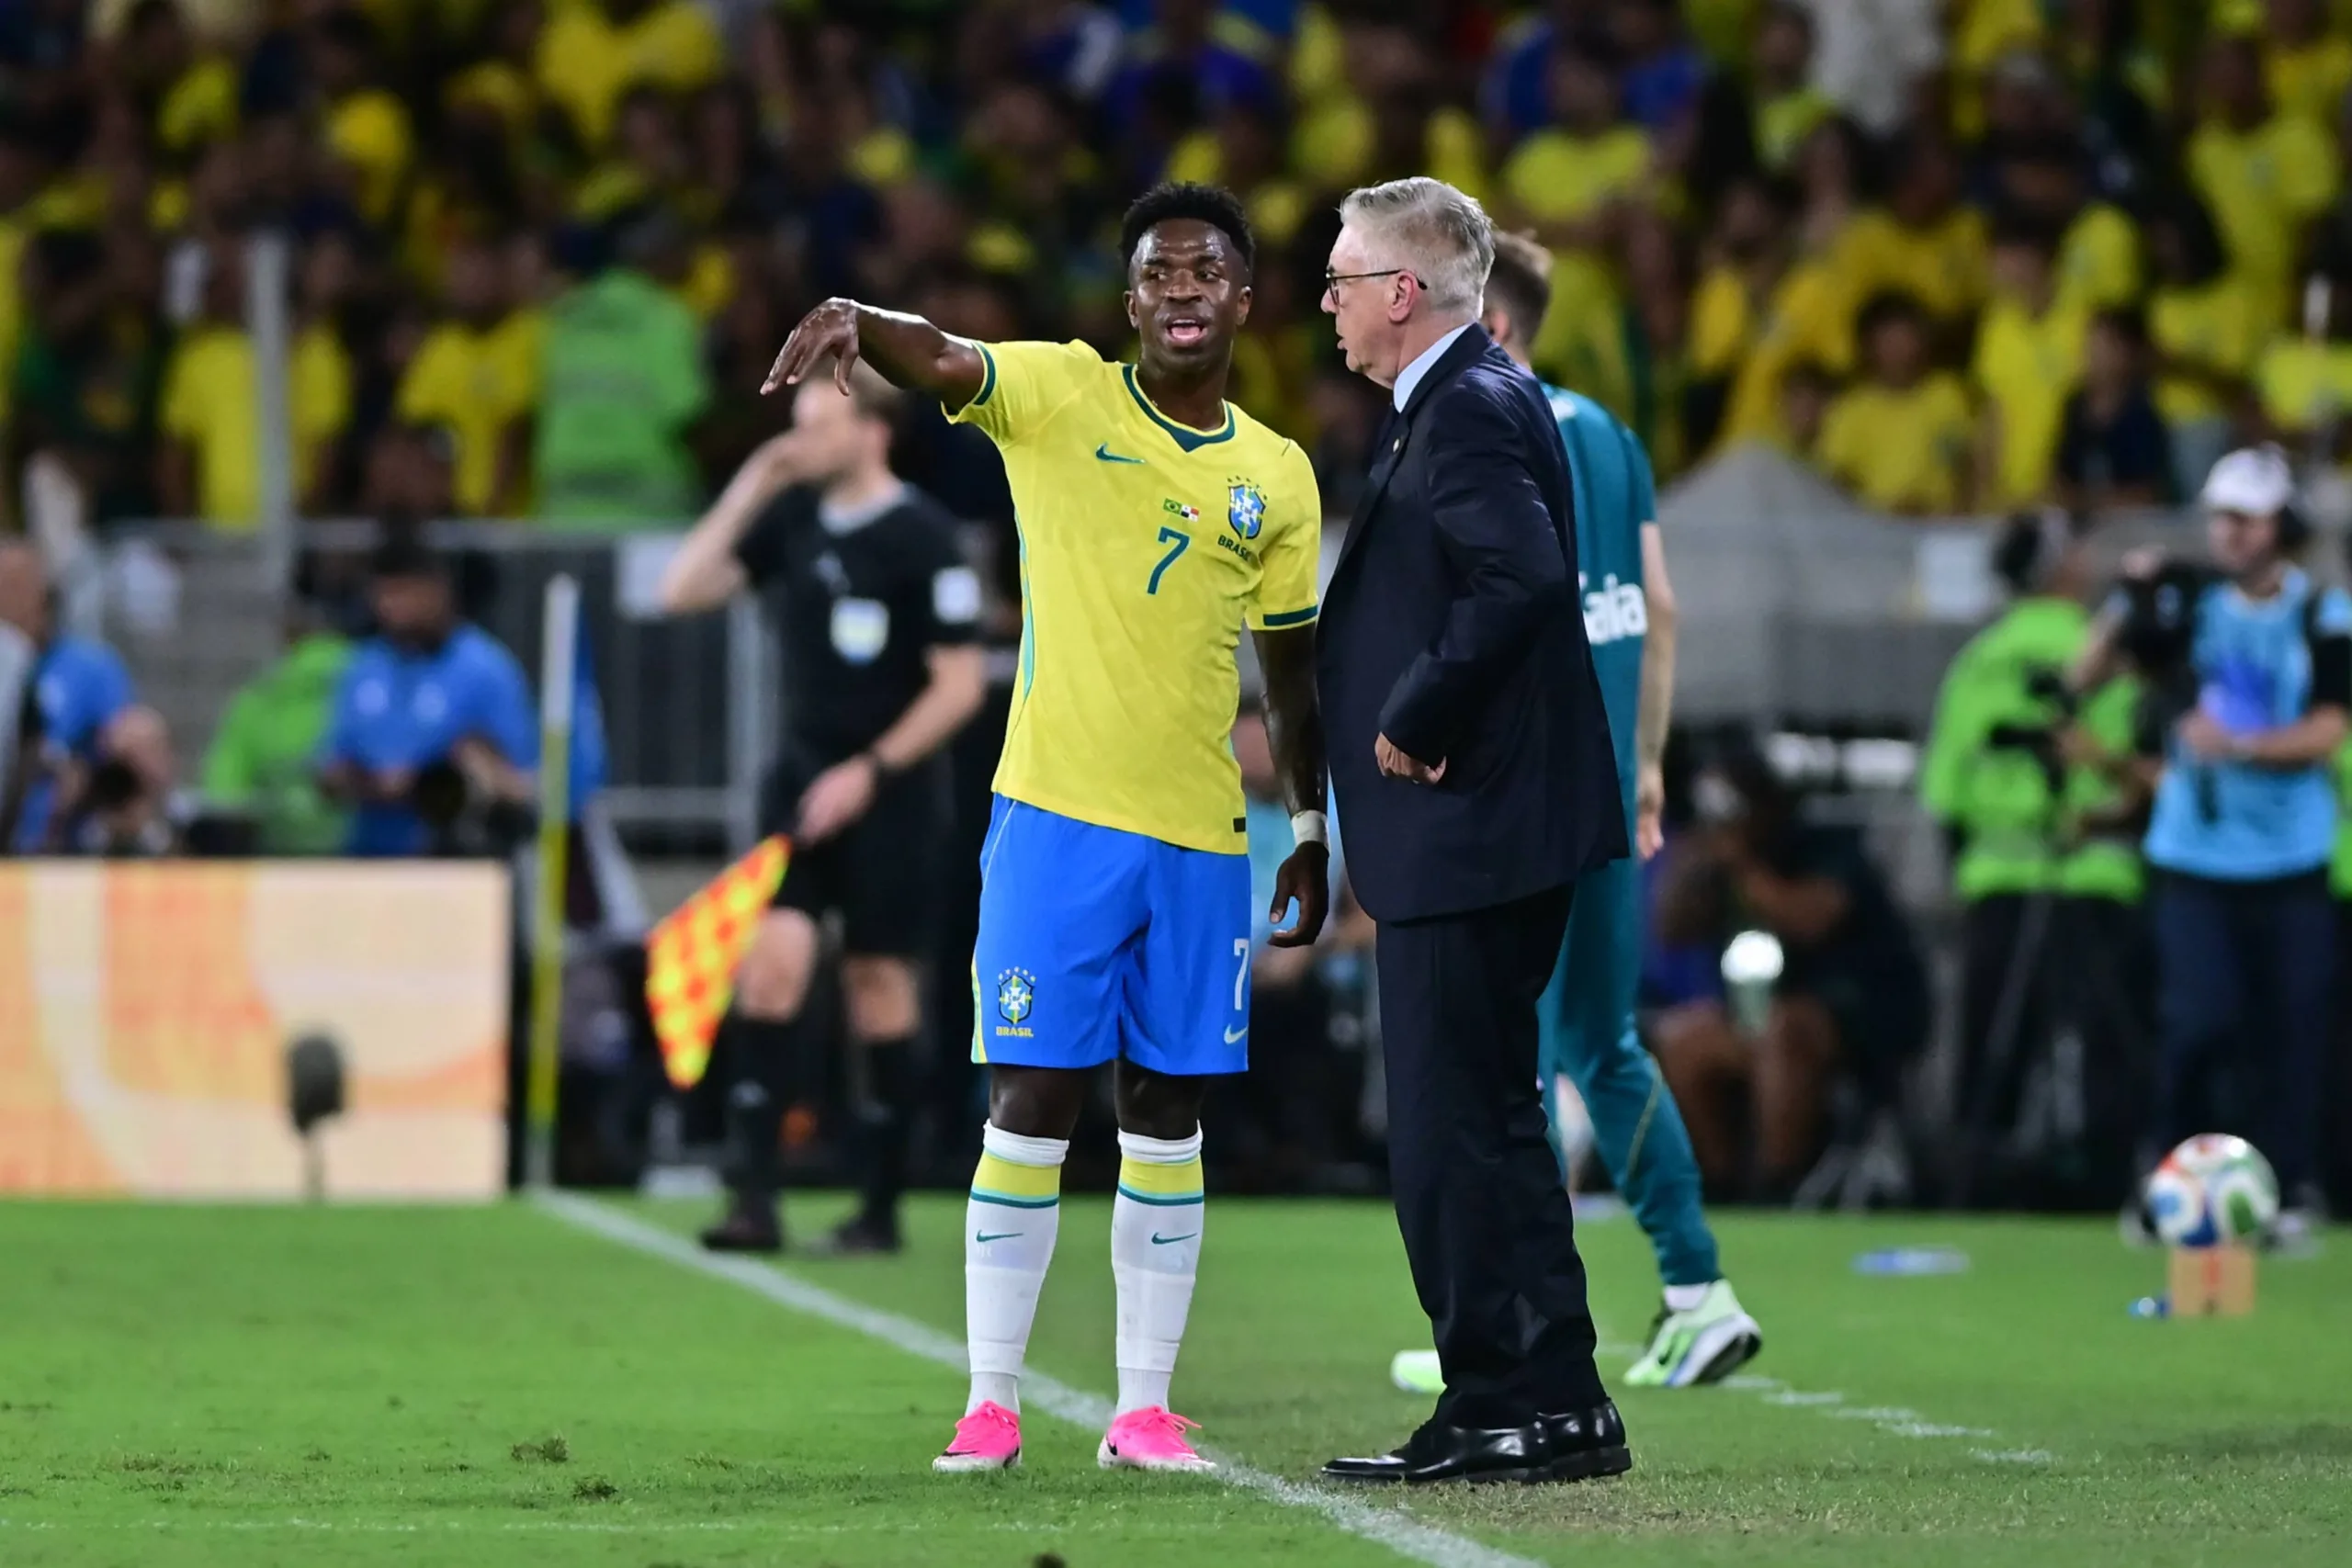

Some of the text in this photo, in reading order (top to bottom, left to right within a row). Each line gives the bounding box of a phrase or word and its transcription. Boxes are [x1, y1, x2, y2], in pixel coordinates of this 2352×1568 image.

[1147, 526, 1191, 595] 7
[1578, 570, 1648, 646] aia
[1234, 938, 1250, 1011] 7
[996, 1025, 1035, 1038] BRASIL
